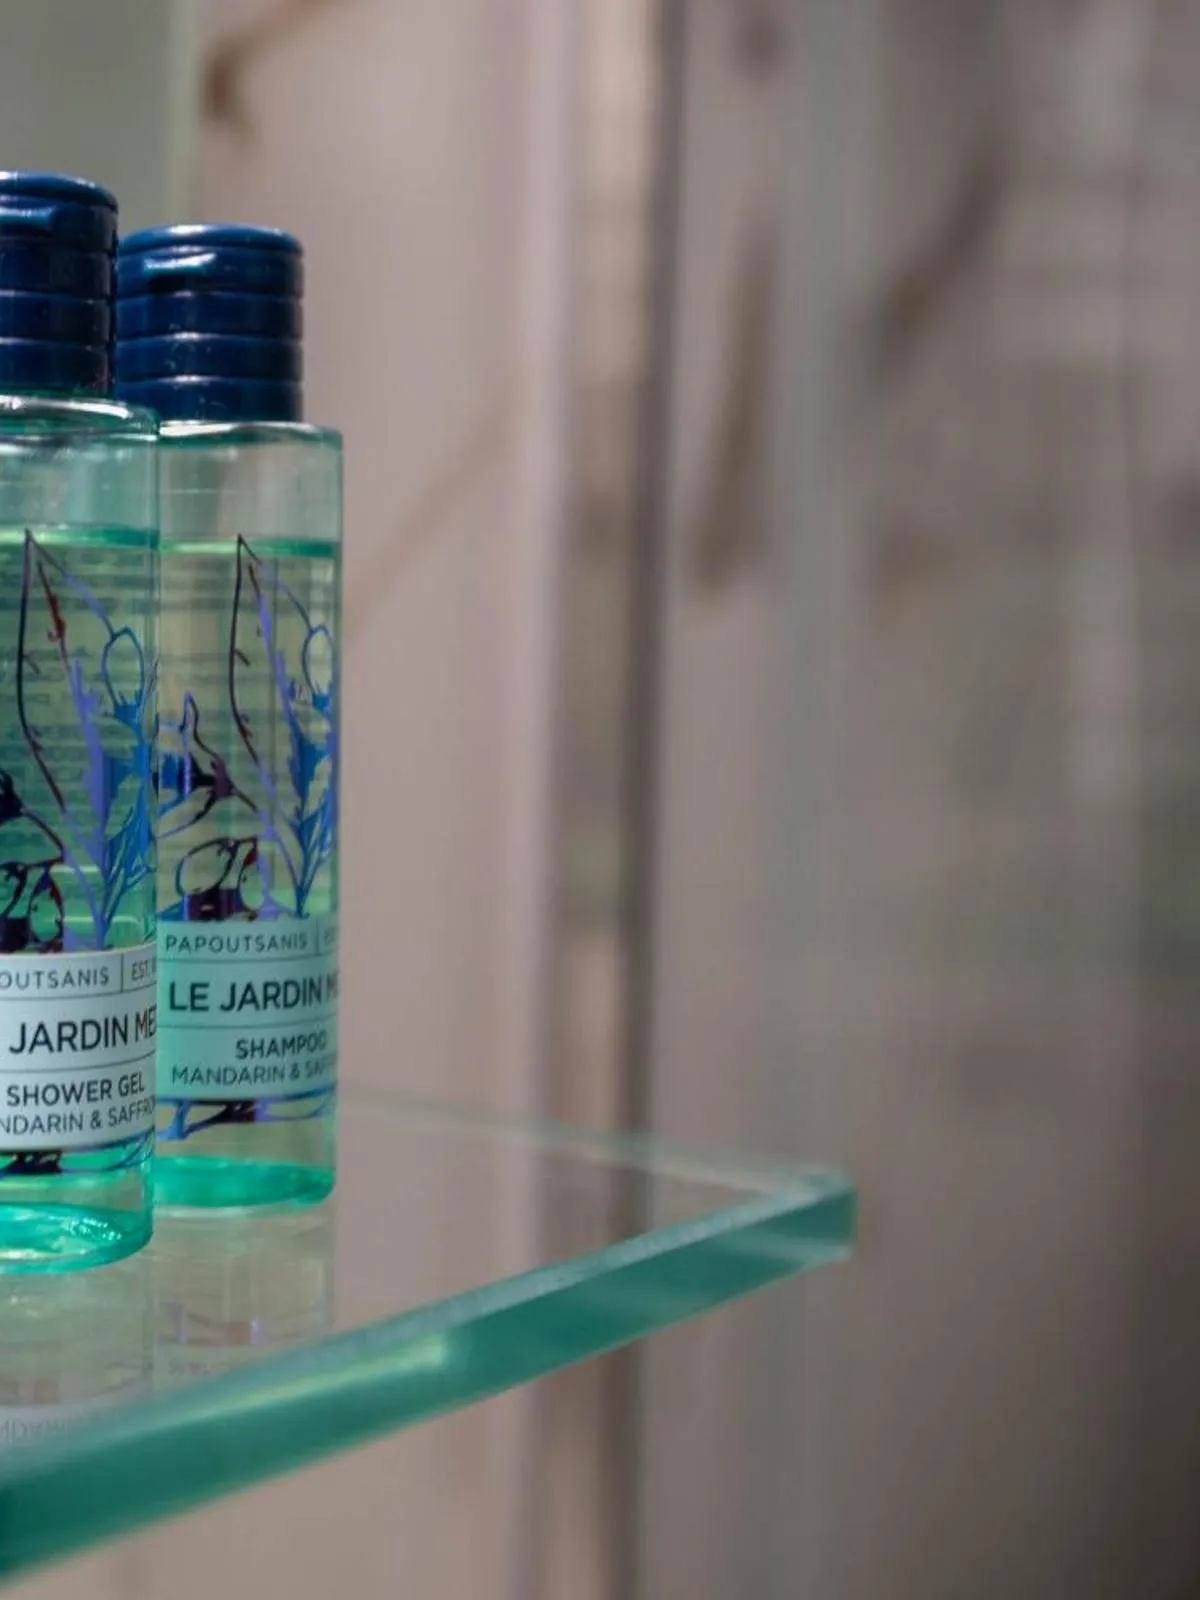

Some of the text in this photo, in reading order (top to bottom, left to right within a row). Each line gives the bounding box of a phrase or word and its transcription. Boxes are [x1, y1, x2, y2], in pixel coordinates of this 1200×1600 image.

[165, 932, 308, 953] PAPOUTSANIS
[169, 981, 209, 1012] LE
[220, 977, 323, 1012] JARDIN
[9, 1014, 128, 1054] JARDIN
[235, 1031, 327, 1060] SHAMPOO
[6, 1072, 145, 1107] SHOWER GEL
[172, 1065, 285, 1086] MANDARIN
[289, 1064, 300, 1081] &
[90, 1112, 103, 1129] &
